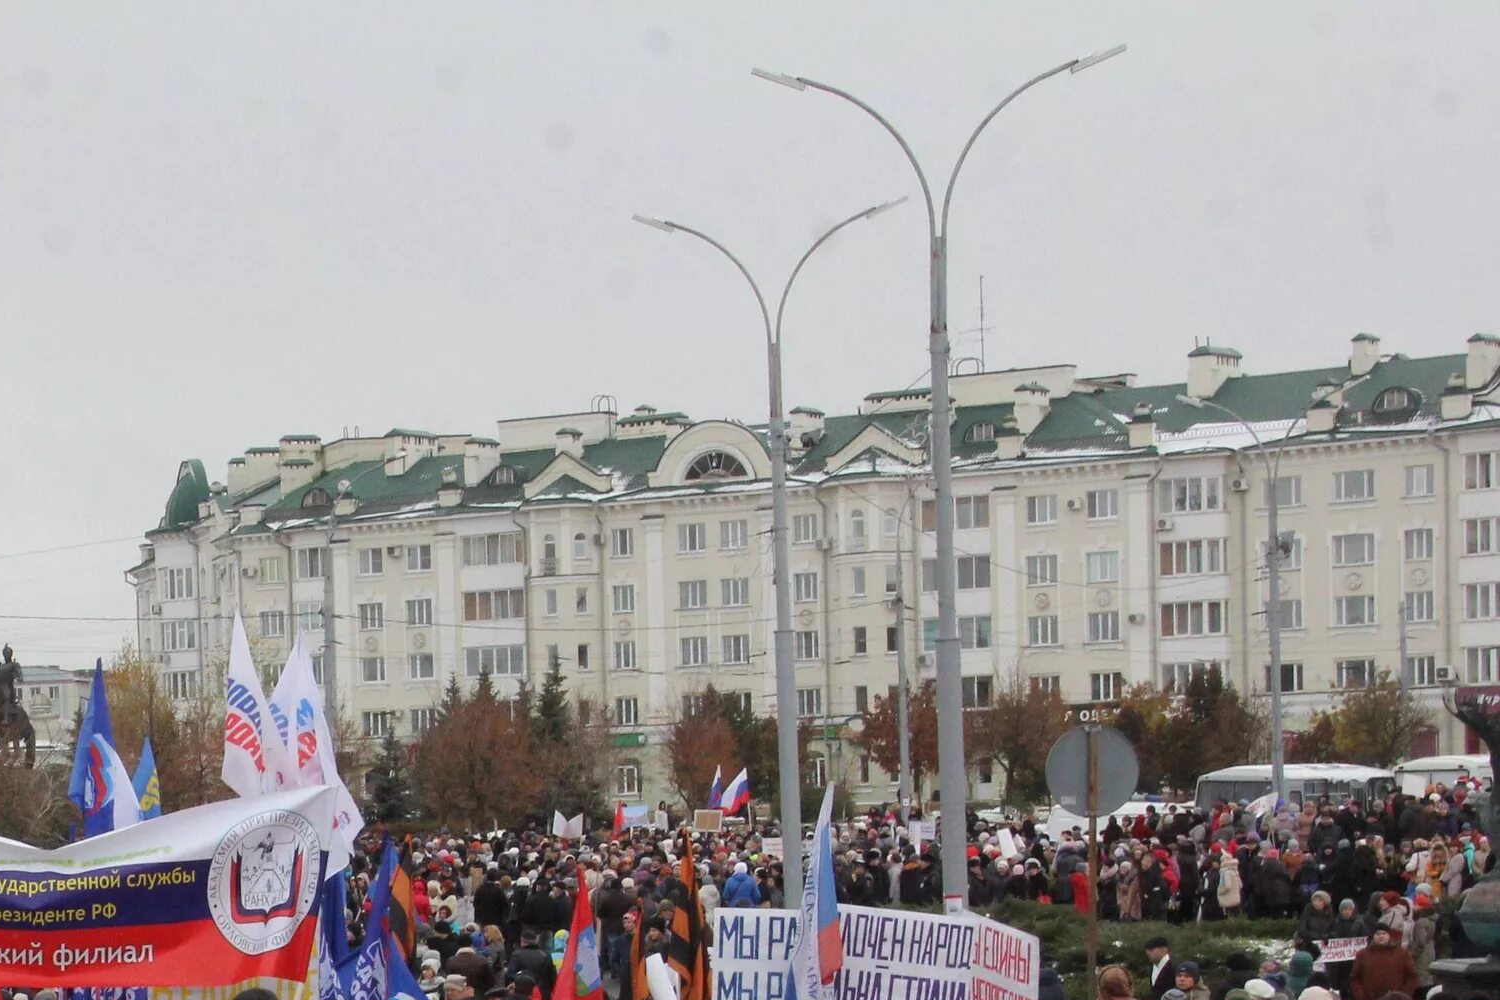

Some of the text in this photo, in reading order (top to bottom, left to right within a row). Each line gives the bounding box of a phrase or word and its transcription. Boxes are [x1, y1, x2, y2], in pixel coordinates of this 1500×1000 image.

[126, 867, 196, 890] службы
[91, 902, 117, 921] РФ
[719, 914, 974, 970] МЫ РА ЛОЧЕН НАРОД
[984, 926, 1031, 985] ЕДИНЫ
[53, 943, 154, 971] филиал
